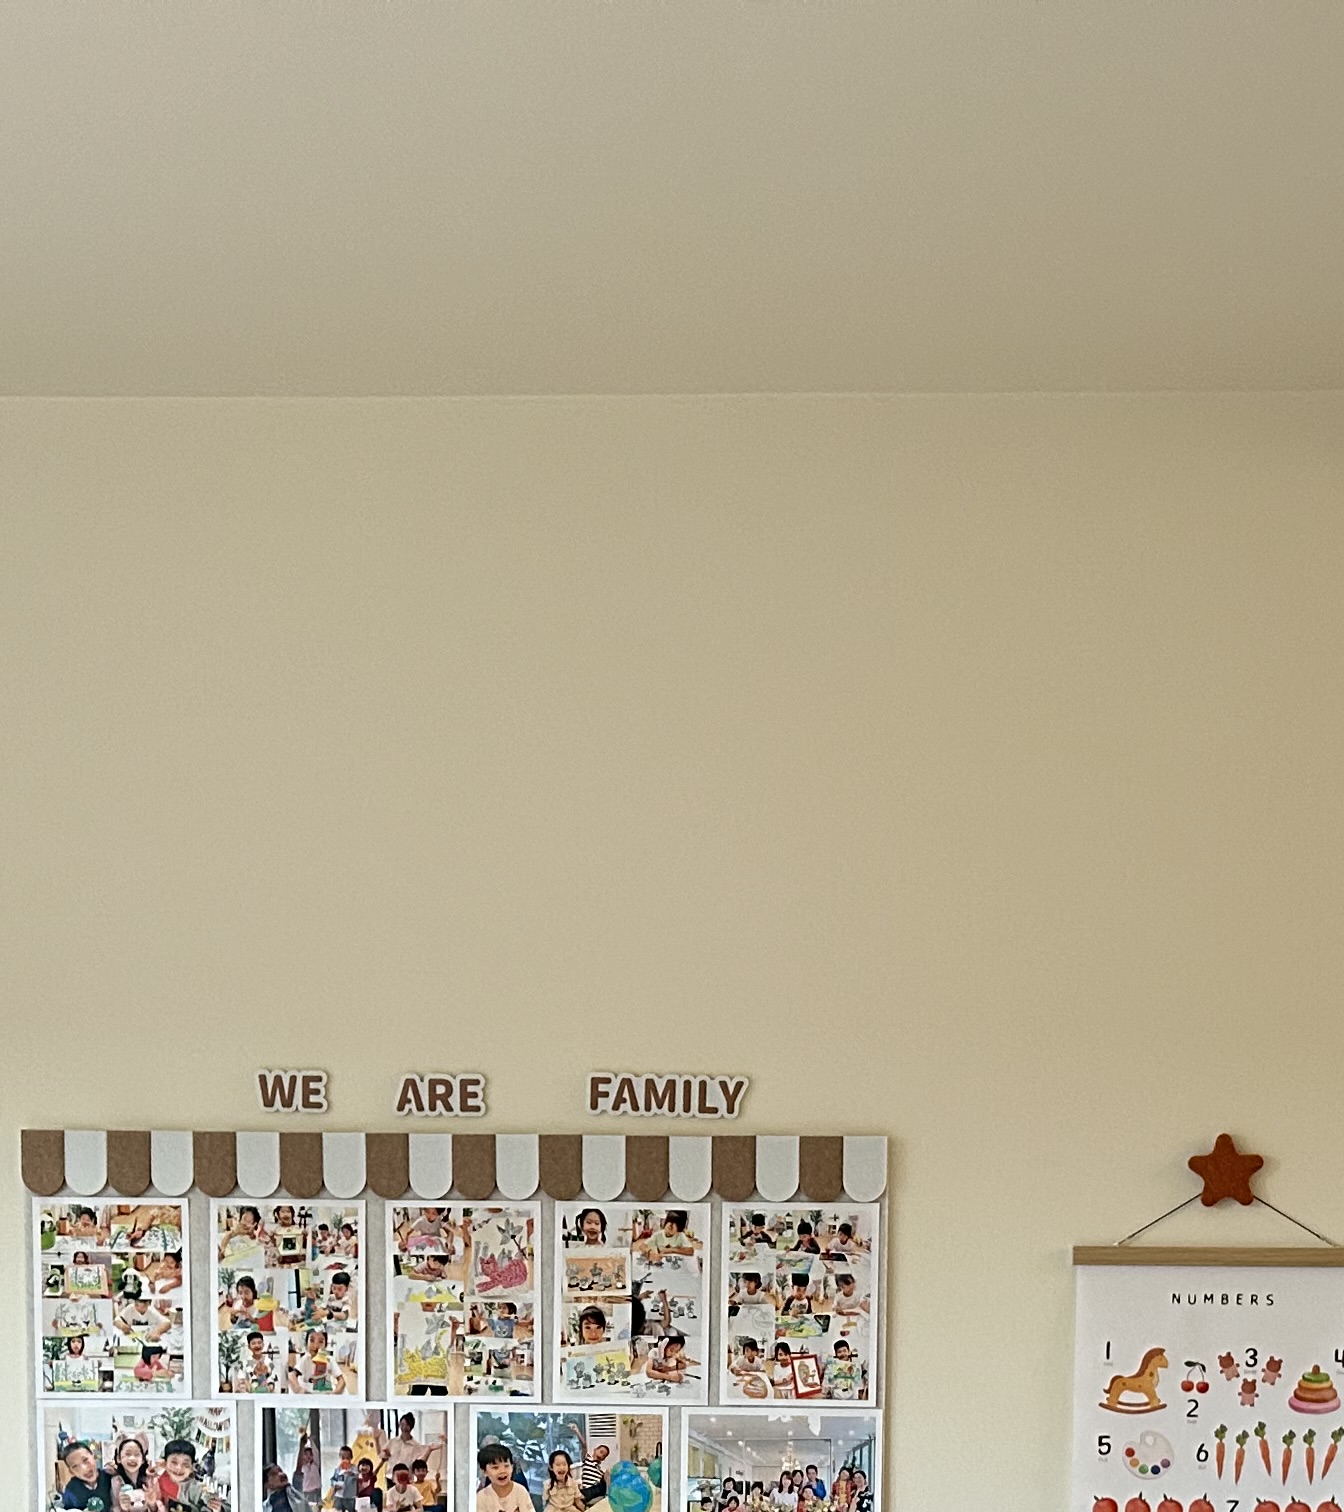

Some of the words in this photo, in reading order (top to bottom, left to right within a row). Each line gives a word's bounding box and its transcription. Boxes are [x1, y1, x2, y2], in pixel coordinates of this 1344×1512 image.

[257, 1072, 325, 1110] WE
[395, 1076, 483, 1113] ARE
[588, 1075, 746, 1116] FAMILY
[1170, 1292, 1275, 1308] NUMBERS
[1104, 1339, 1112, 1361] 1
[1245, 1347, 1258, 1368] 3
[1186, 1398, 1199, 1418] 2
[1097, 1435, 1112, 1456] 5
[1196, 1442, 1209, 1463] 6
